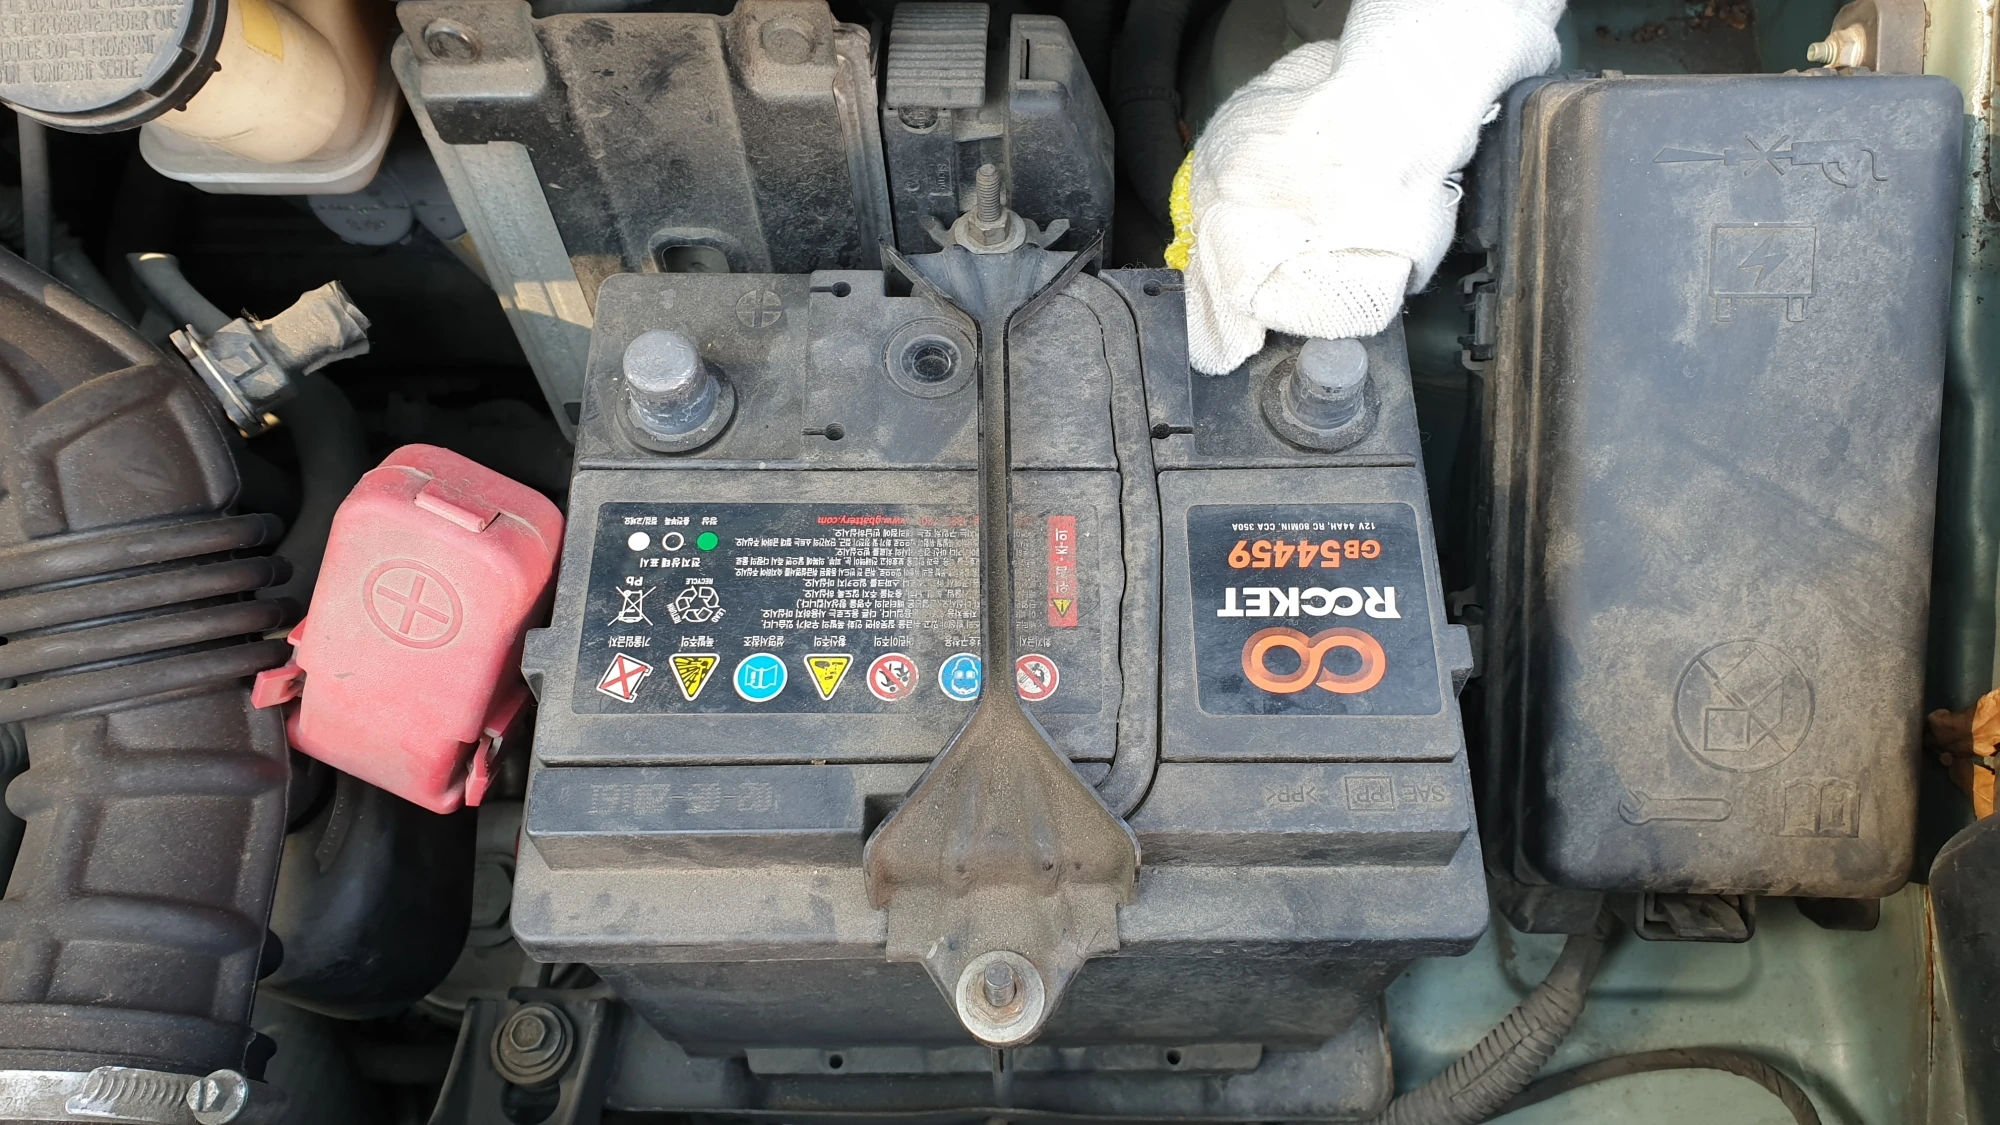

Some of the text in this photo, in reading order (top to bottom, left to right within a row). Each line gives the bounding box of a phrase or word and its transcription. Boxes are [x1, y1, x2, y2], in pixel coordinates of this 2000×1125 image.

[701, 516, 718, 525] 정상
[1359, 521, 1375, 530] 12V
[1231, 522, 1254, 531] 350A
[1257, 522, 1275, 531] CCA
[1312, 522, 1325, 531] RC
[1327, 521, 1354, 531] 44AH,
[832, 528, 881, 538] 반납하십시오.
[835, 546, 871, 556] 받으십시오.
[873, 546, 893, 556] 치료를
[1227, 539, 1381, 568] GB54459
[639, 557, 701, 568] 전지상태 표시
[838, 567, 856, 576] 반드시
[856, 567, 863, 576] 전
[625, 576, 644, 586] Pb
[685, 577, 714, 585] RECYCLE
[802, 578, 835, 587] 마십시오.
[837, 578, 867, 587] 일으키지
[870, 578, 900, 587] 스파크를
[802, 588, 835, 598] 하십시오.
[837, 588, 860, 598] 않도록
[862, 588, 877, 598] 주지
[849, 598, 872, 608] 수명을
[874, 598, 904, 608] 배터리의
[1217, 586, 1401, 618] ROCKET
[666, 602, 682, 624] RETURN
[710, 607, 726, 623] LEAD
[760, 608, 793, 618] 마십시오.
[795, 608, 827, 618] 사용하지
[828, 608, 859, 618] 용도로는
[861, 608, 876, 618] 다른
[761, 619, 793, 629] 있습니다.
[796, 619, 820, 629] 우려가
[847, 619, 863, 629] 인화
[865, 619, 895, 629] 잘못하면
[680, 635, 714, 647] 폭발주의
[744, 635, 784, 647] 설명서참조
[813, 635, 846, 647] 황산주의
[1353, 785, 1385, 802] PP
[1402, 784, 1445, 802] SAE
